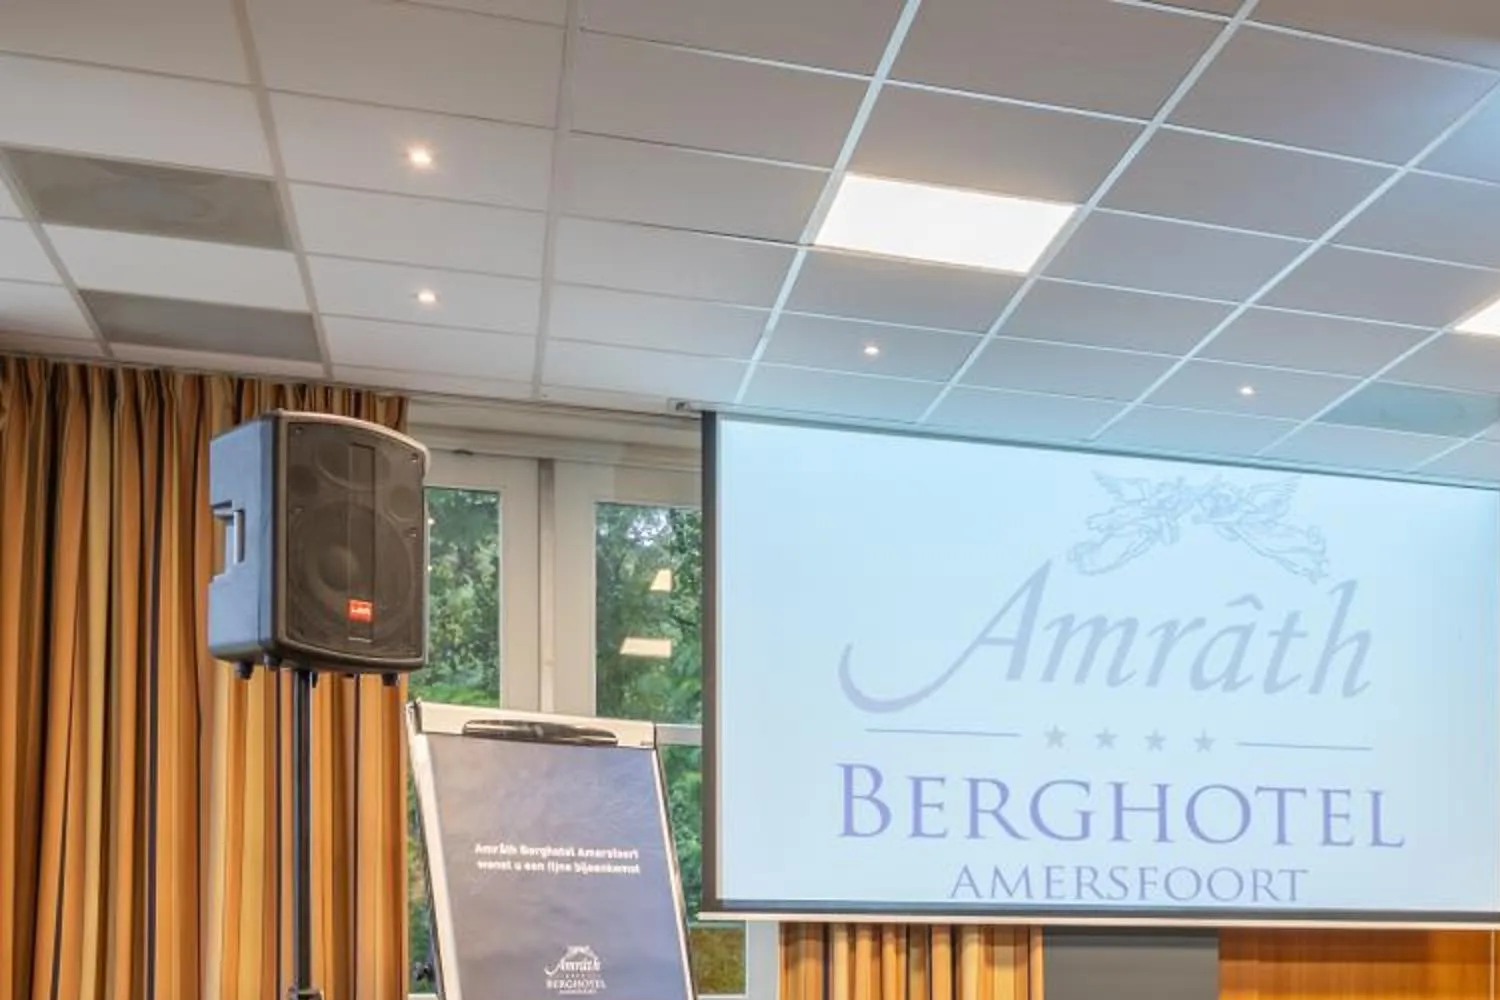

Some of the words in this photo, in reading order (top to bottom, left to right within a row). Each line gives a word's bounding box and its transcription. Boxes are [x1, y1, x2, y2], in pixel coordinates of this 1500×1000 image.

[838, 558, 1372, 713] Amrâth
[836, 763, 1405, 848] BERGHOTEL
[949, 864, 1310, 902] AMERSFOORT
